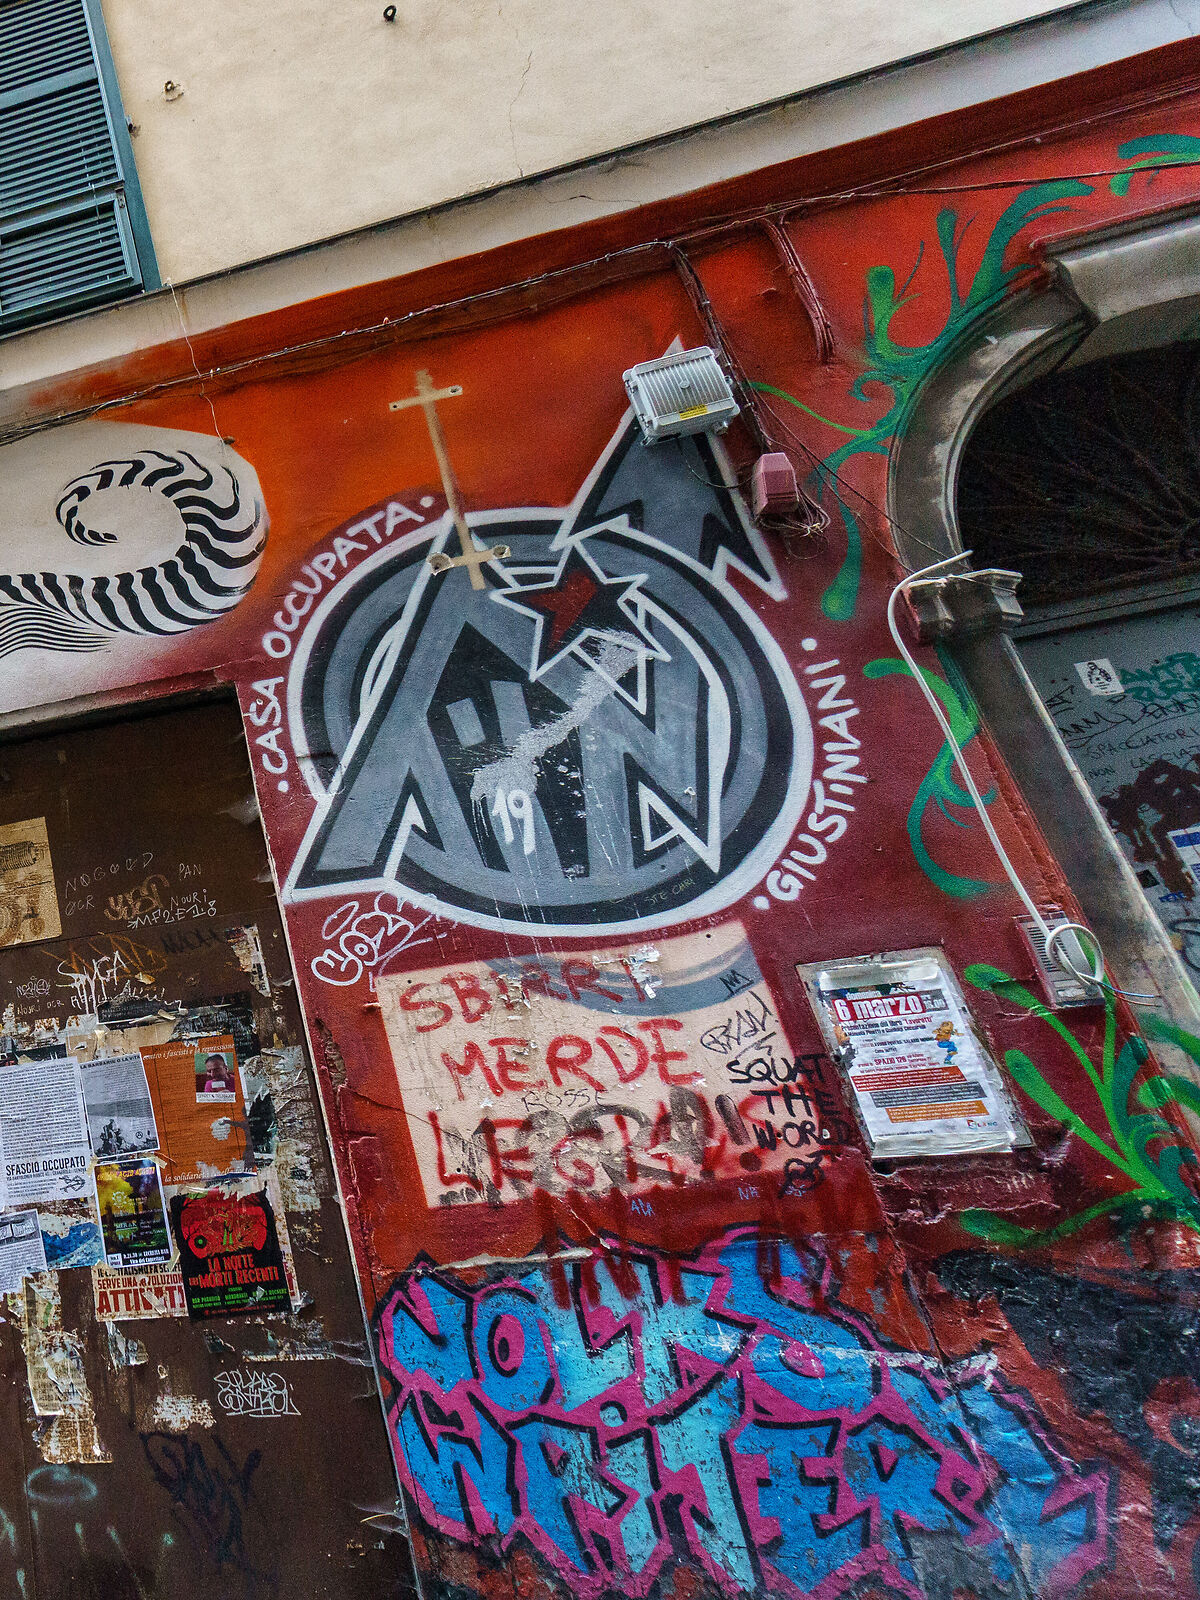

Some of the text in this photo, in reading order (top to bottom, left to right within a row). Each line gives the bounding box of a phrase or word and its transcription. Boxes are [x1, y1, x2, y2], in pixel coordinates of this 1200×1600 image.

[261, 498, 424, 660] OCCUPATA
[255, 675, 285, 777] CASA
[767, 656, 868, 902] GIUSTINIANI
[490, 787, 539, 856] 19
[834, 995, 924, 1021] 6 marzo
[165, 1048, 189, 1060] fascisti
[440, 1018, 701, 1100] MERDE
[726, 1053, 829, 1087] SQUAT
[750, 1083, 842, 1118] THE
[5, 1155, 86, 1176] SFASCIO OCCUPATO
[105, 1264, 148, 1277] CITALISMO
[198, 1270, 234, 1289] MORTI
[235, 1266, 280, 1285] RECENTI
[207, 1254, 255, 1273] LA NOTTE
[97, 1278, 121, 1290] SERVE
[122, 1276, 138, 1288] UNA
